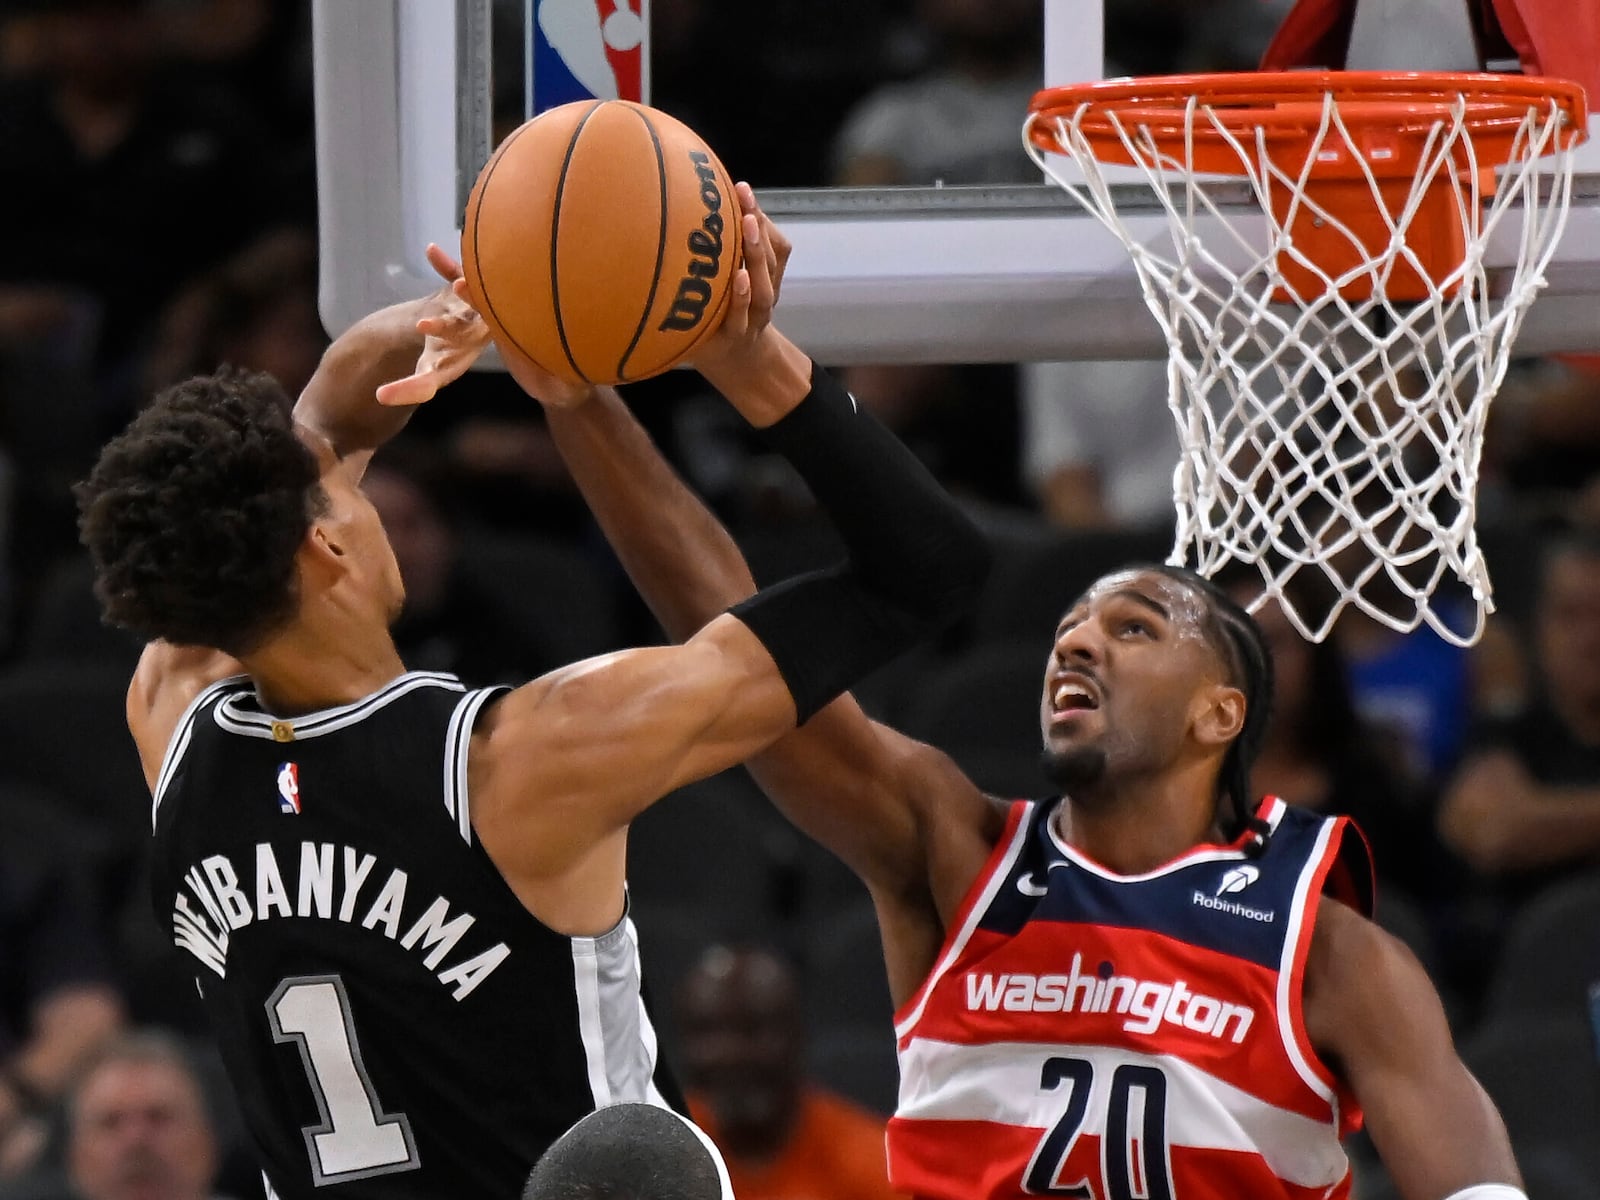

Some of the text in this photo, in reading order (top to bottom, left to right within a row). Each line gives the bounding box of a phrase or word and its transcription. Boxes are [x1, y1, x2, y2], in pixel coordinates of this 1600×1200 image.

[658, 152, 723, 331] Wilson
[1193, 890, 1275, 922] Robinhood
[966, 952, 1255, 1044] washington
[264, 974, 421, 1187] 1
